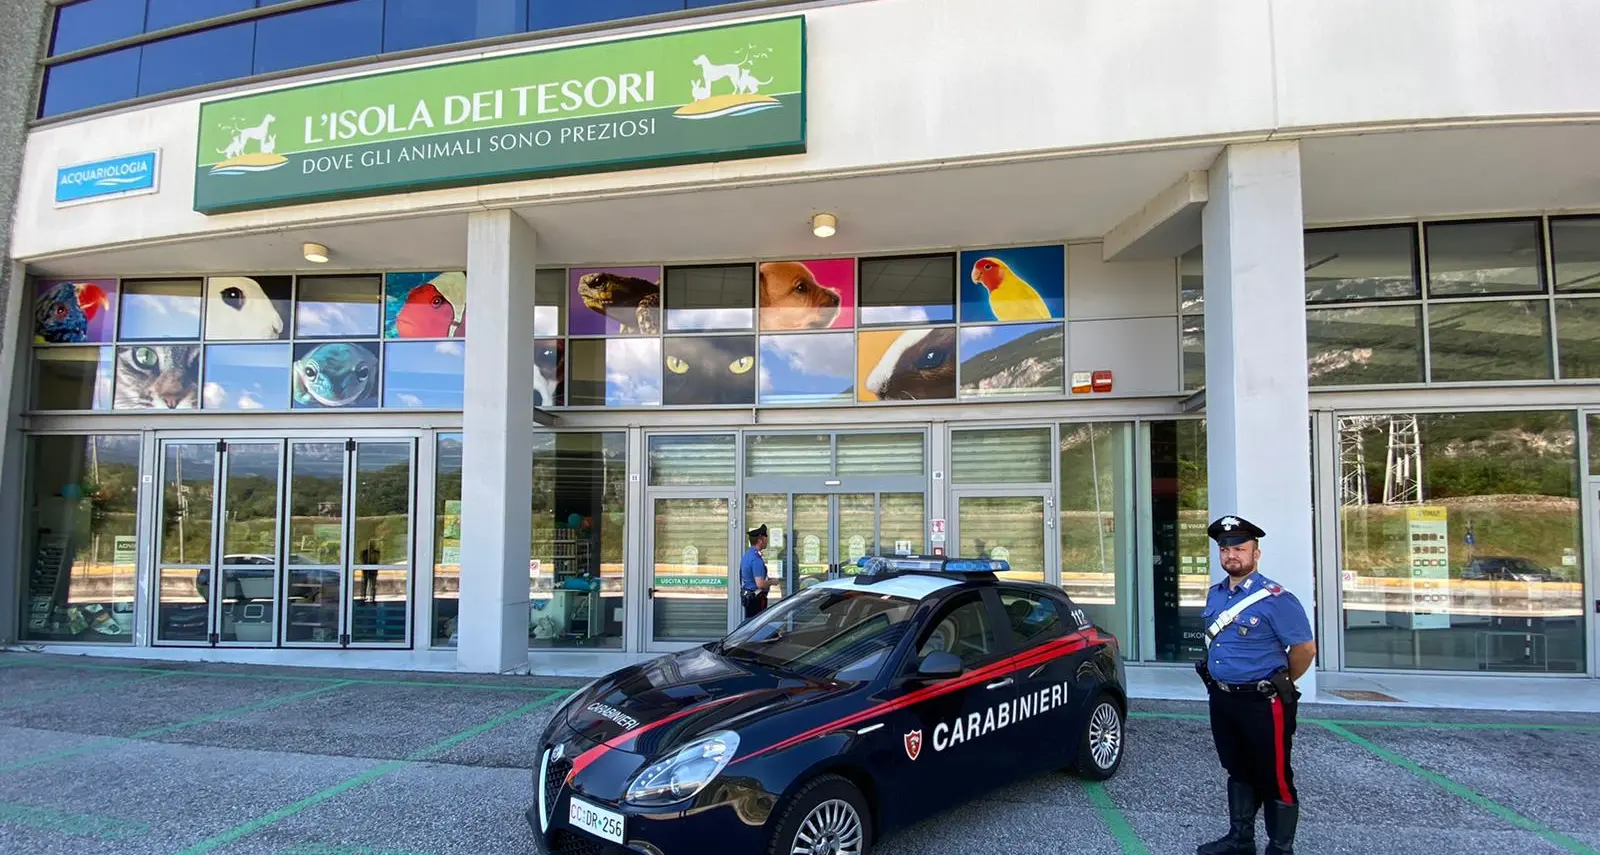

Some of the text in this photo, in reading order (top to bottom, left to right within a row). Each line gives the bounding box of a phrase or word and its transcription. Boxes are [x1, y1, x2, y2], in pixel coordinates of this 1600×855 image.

[304, 70, 655, 144] L’ISOLA DEI TESORI
[303, 118, 655, 174] DOVE GLI ANIMALI SONO PREZIOSI
[61, 160, 148, 186] ACQUARIOLOGIA
[660, 578, 680, 586] USCITA
[682, 578, 689, 586] DI
[587, 702, 640, 731] CARABINIERI
[933, 681, 1068, 752] CARABINIERI
[602, 816, 622, 837] 256
